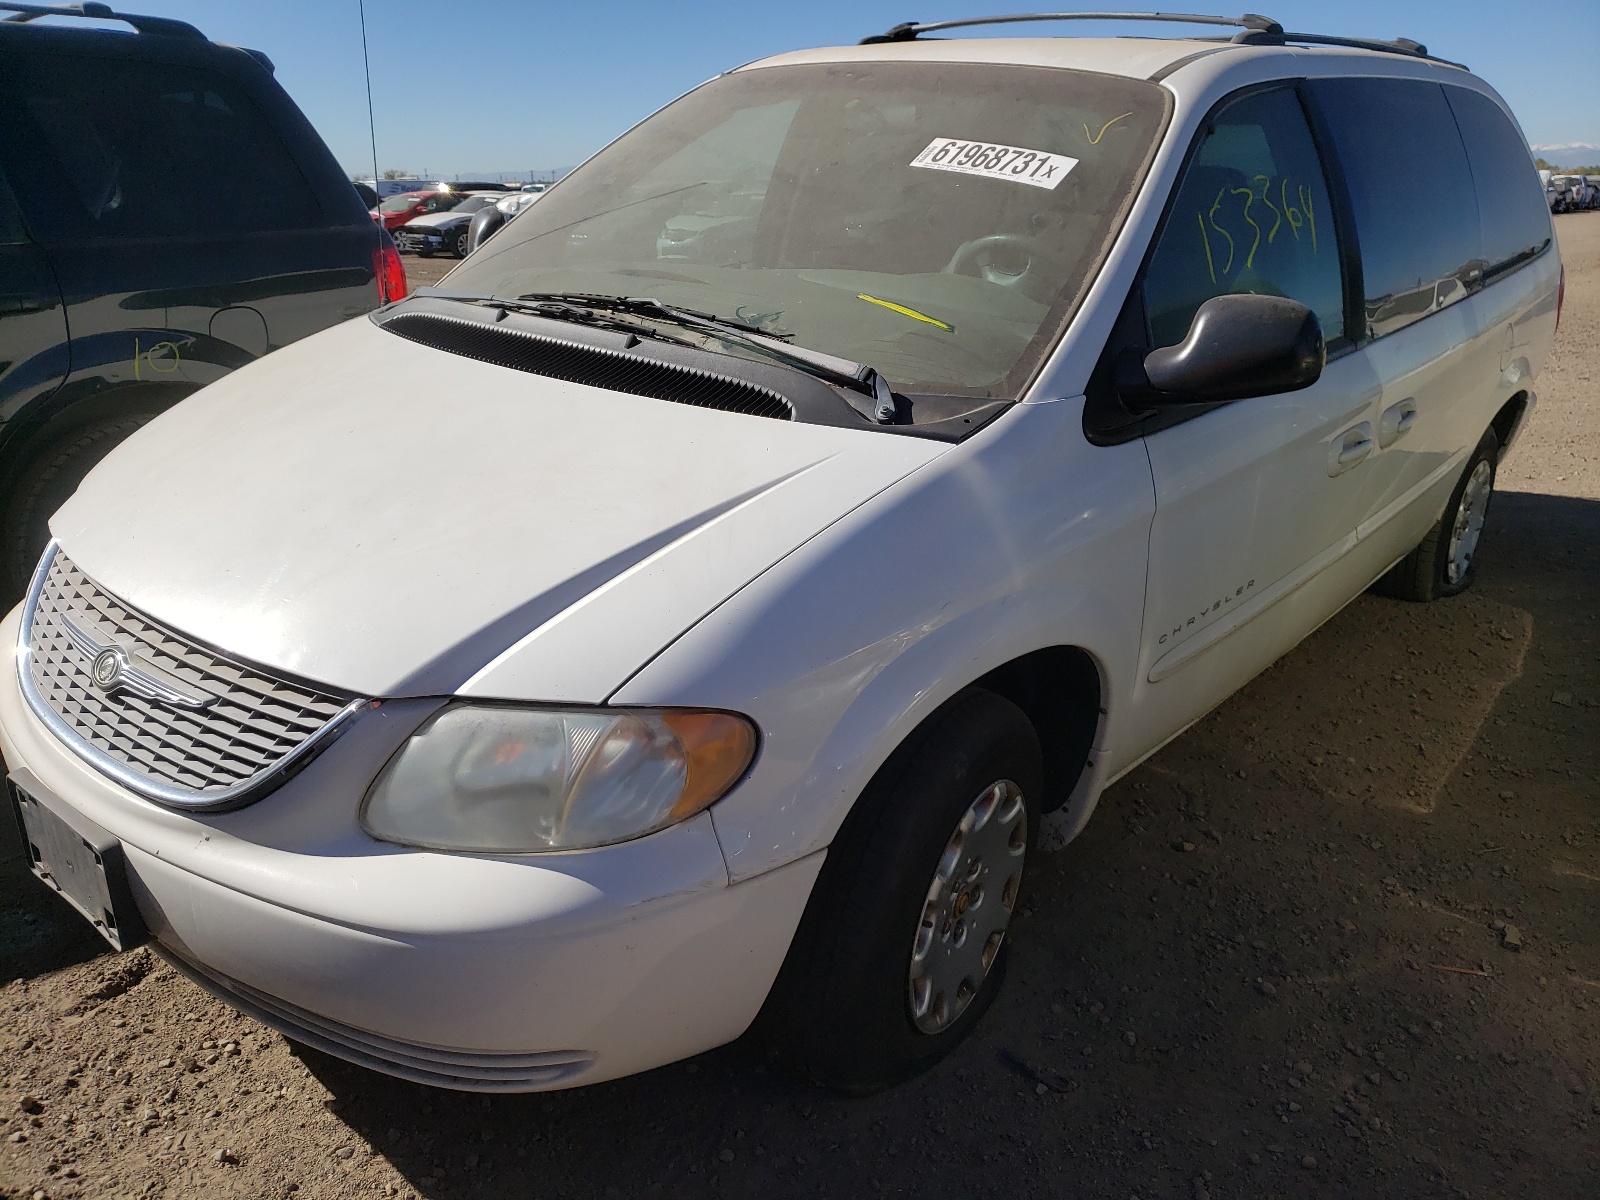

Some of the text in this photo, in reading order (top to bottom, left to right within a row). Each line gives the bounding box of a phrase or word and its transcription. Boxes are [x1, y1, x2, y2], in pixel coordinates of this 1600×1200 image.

[1198, 174, 1317, 284] 153364
[134, 337, 180, 381] 10
[1158, 579, 1255, 645] CHRYSLER
